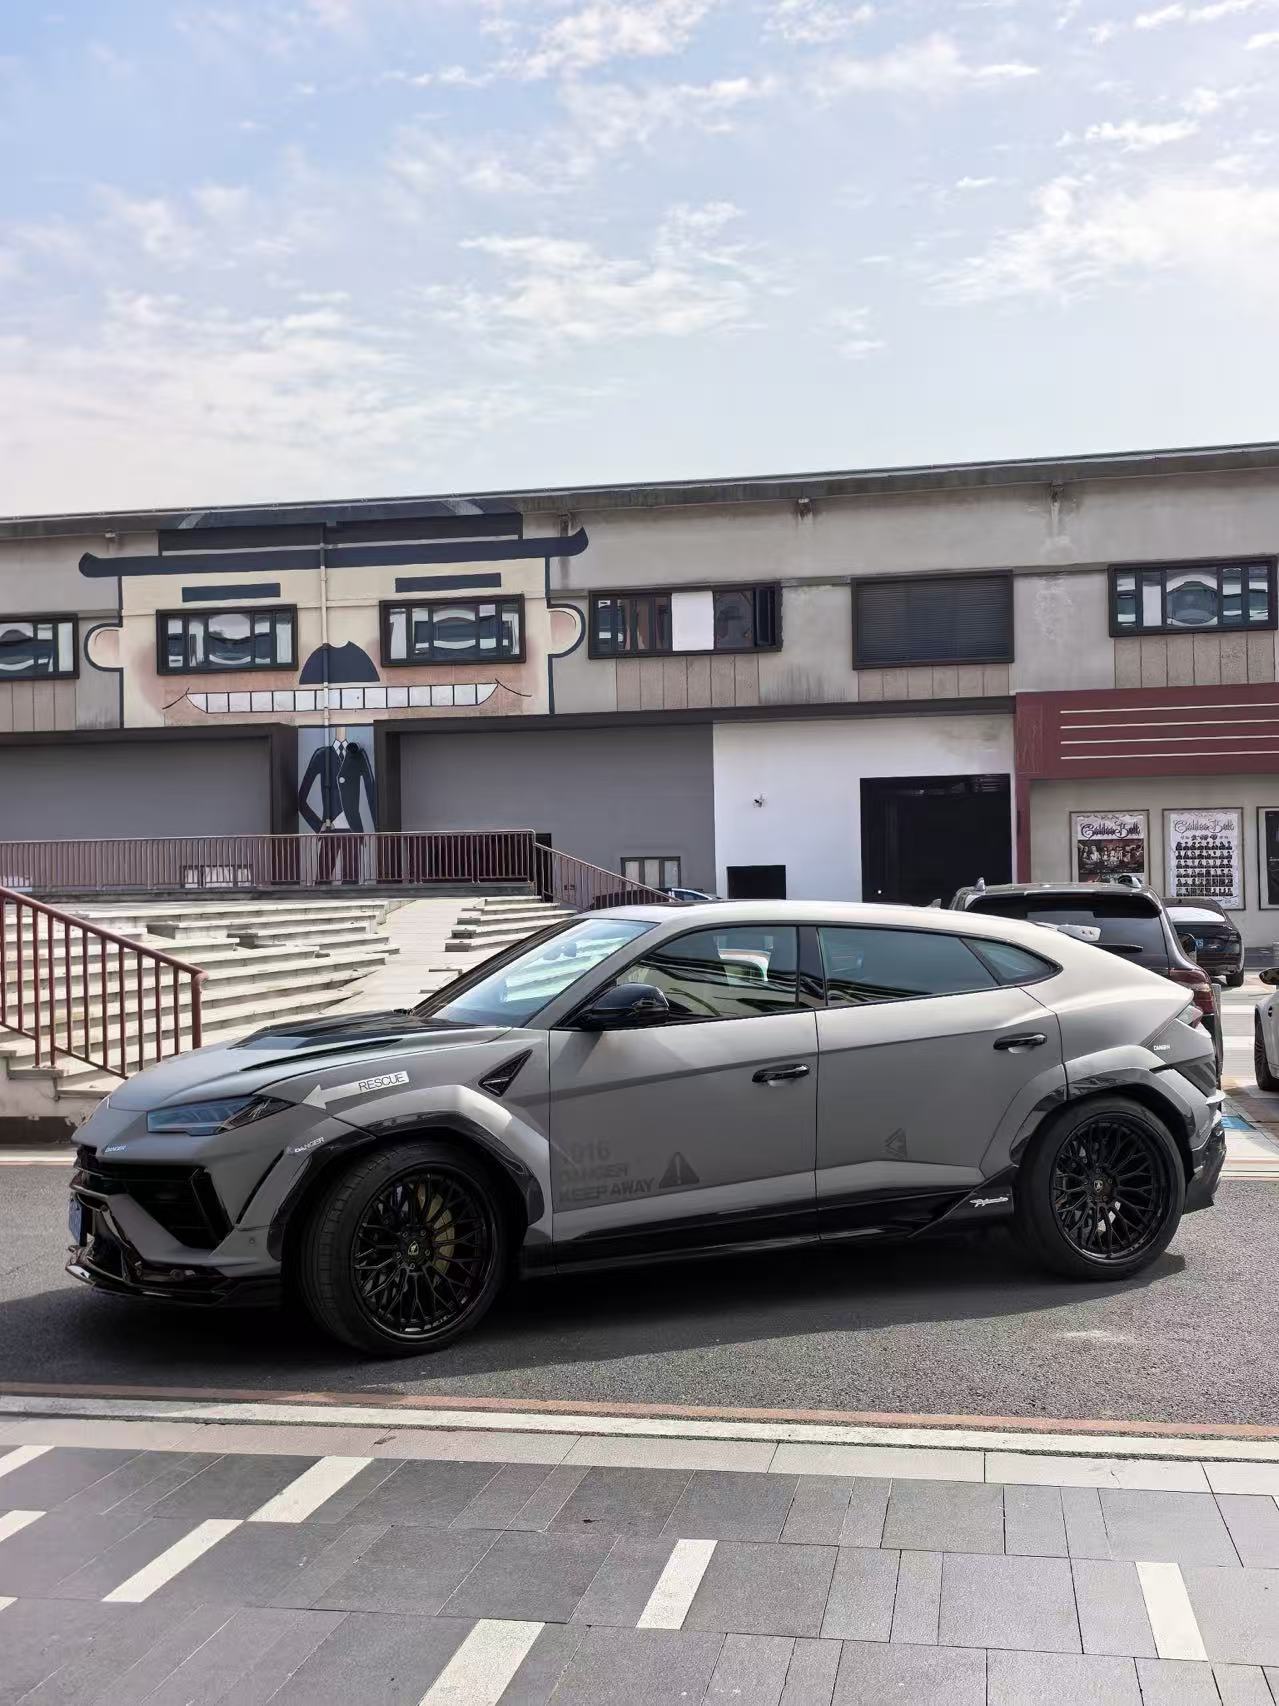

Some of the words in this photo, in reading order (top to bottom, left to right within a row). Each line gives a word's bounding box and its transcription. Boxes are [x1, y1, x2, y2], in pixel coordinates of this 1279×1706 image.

[358, 1073, 404, 1092] RESCUE
[294, 1136, 325, 1153] DANGER
[609, 1177, 656, 1197] AWAY
